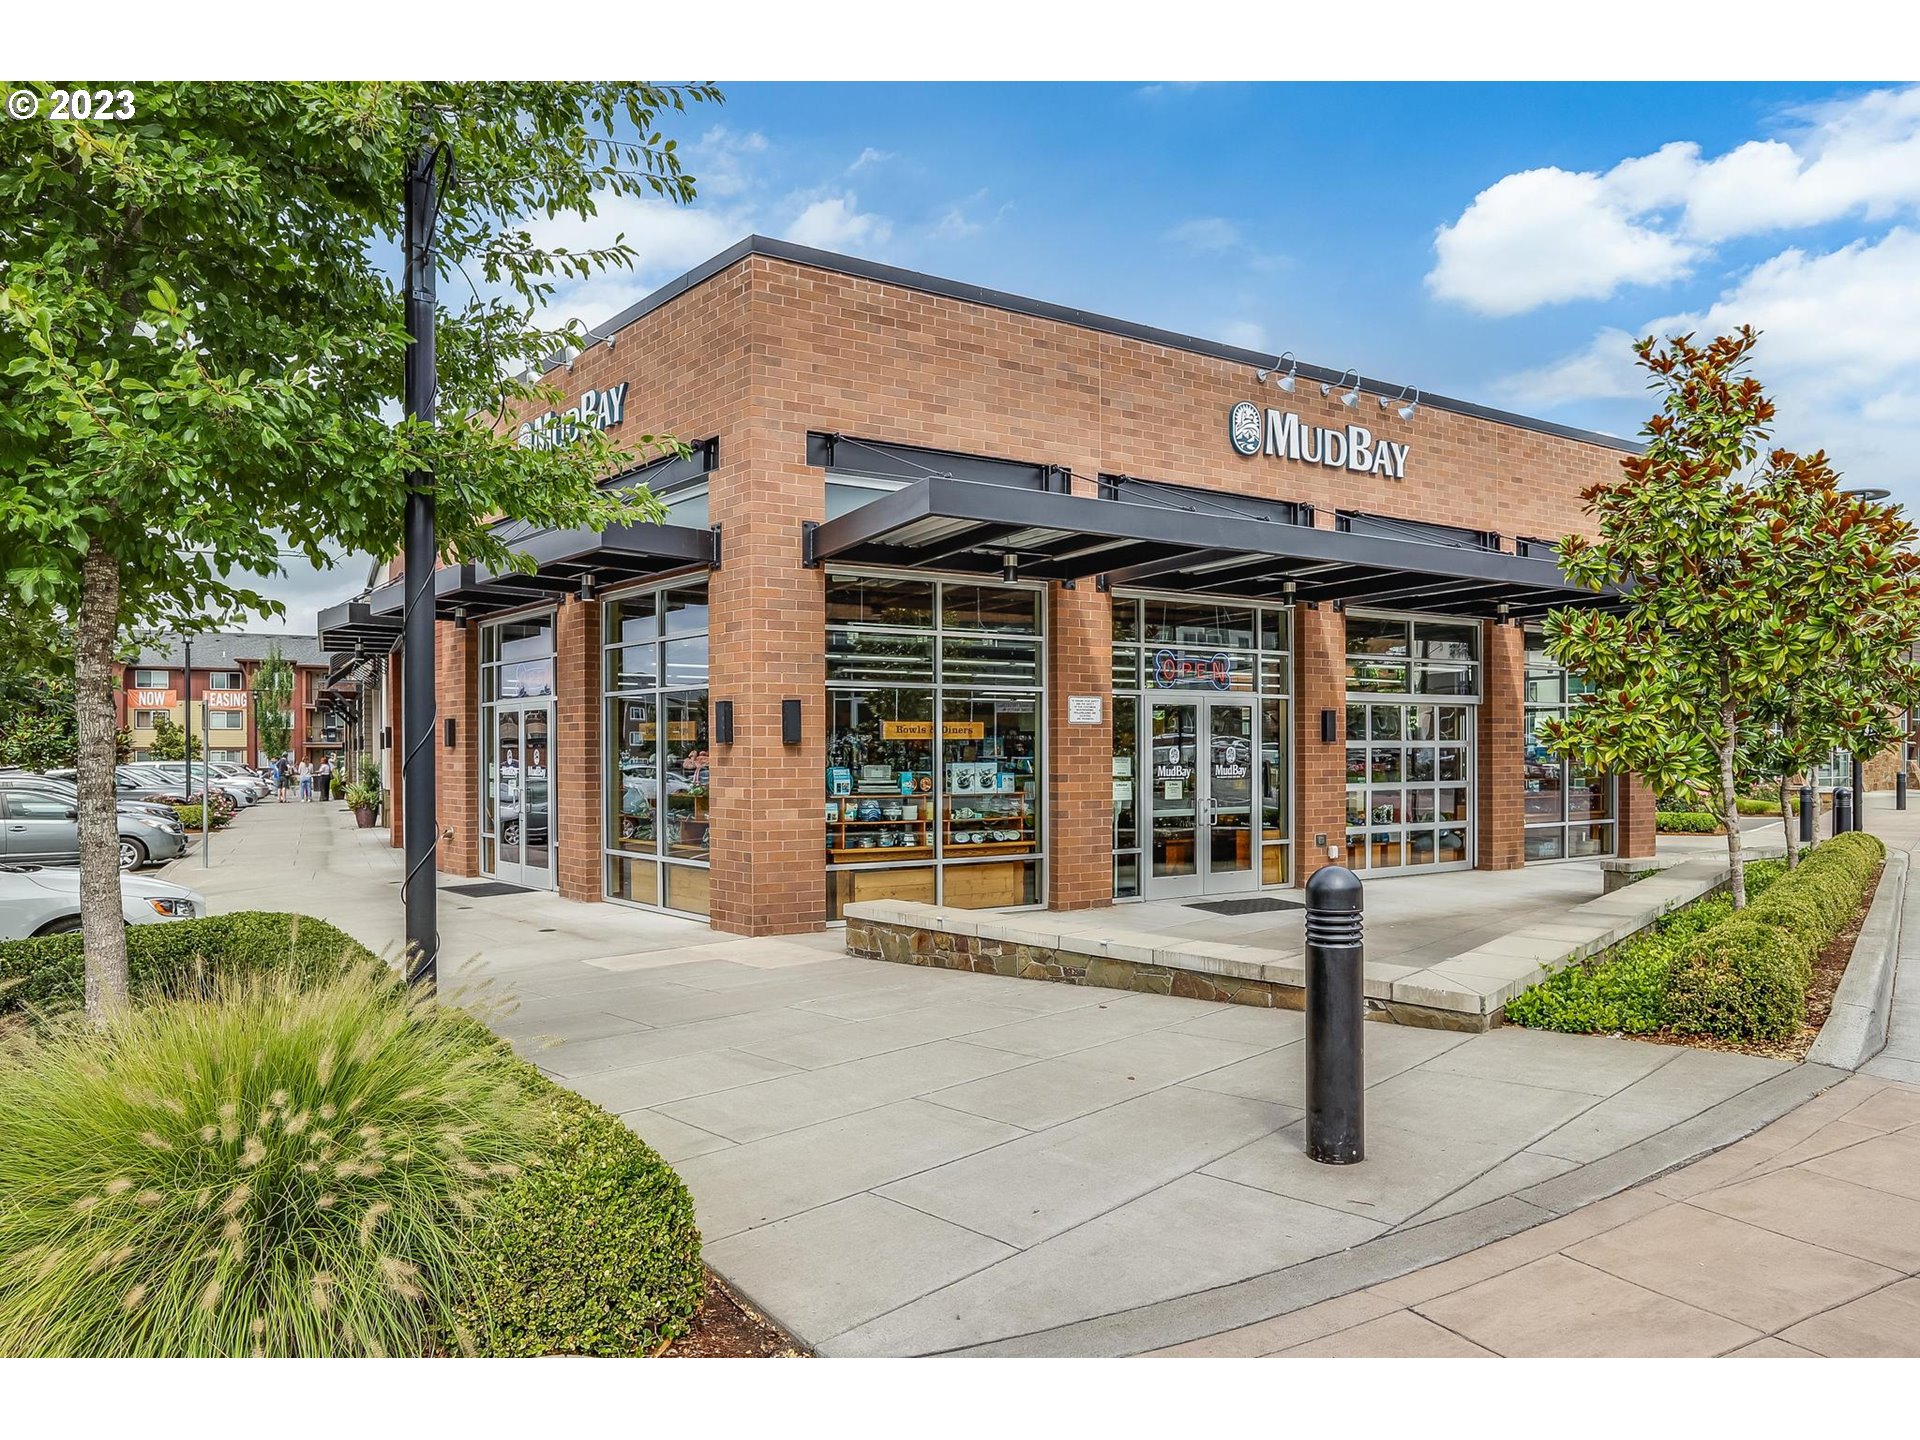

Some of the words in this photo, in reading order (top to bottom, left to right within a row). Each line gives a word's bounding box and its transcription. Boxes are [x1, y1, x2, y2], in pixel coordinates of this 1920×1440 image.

[1163, 659, 1226, 682] OPEN
[138, 691, 166, 706] NOW
[203, 692, 248, 707] LEASING
[896, 725, 926, 734] Bowls
[942, 726, 974, 735] Diners
